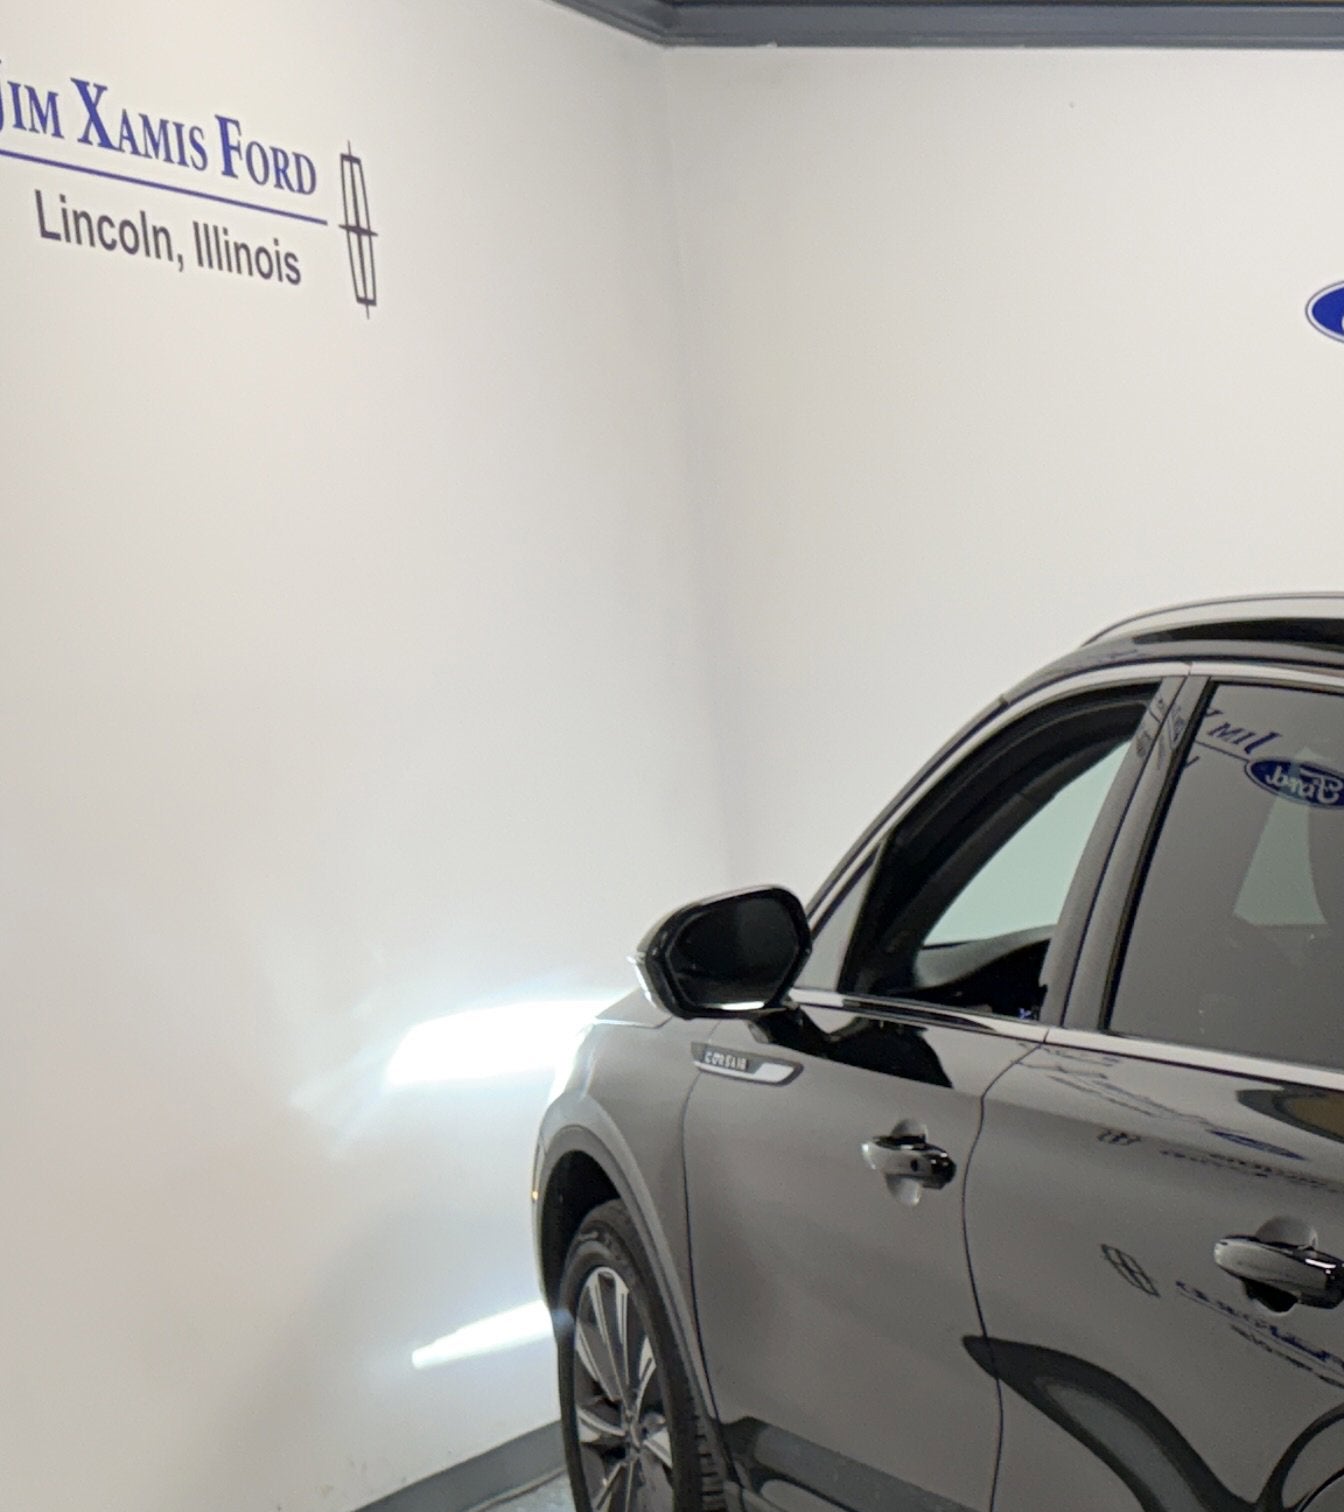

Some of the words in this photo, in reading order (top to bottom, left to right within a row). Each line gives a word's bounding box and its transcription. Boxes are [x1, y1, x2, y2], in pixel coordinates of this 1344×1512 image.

[0, 66, 65, 139] IM
[71, 77, 209, 171] XAMIS
[214, 114, 318, 196] FORD
[35, 189, 185, 272] Lincoln,
[193, 220, 302, 286] Illinois
